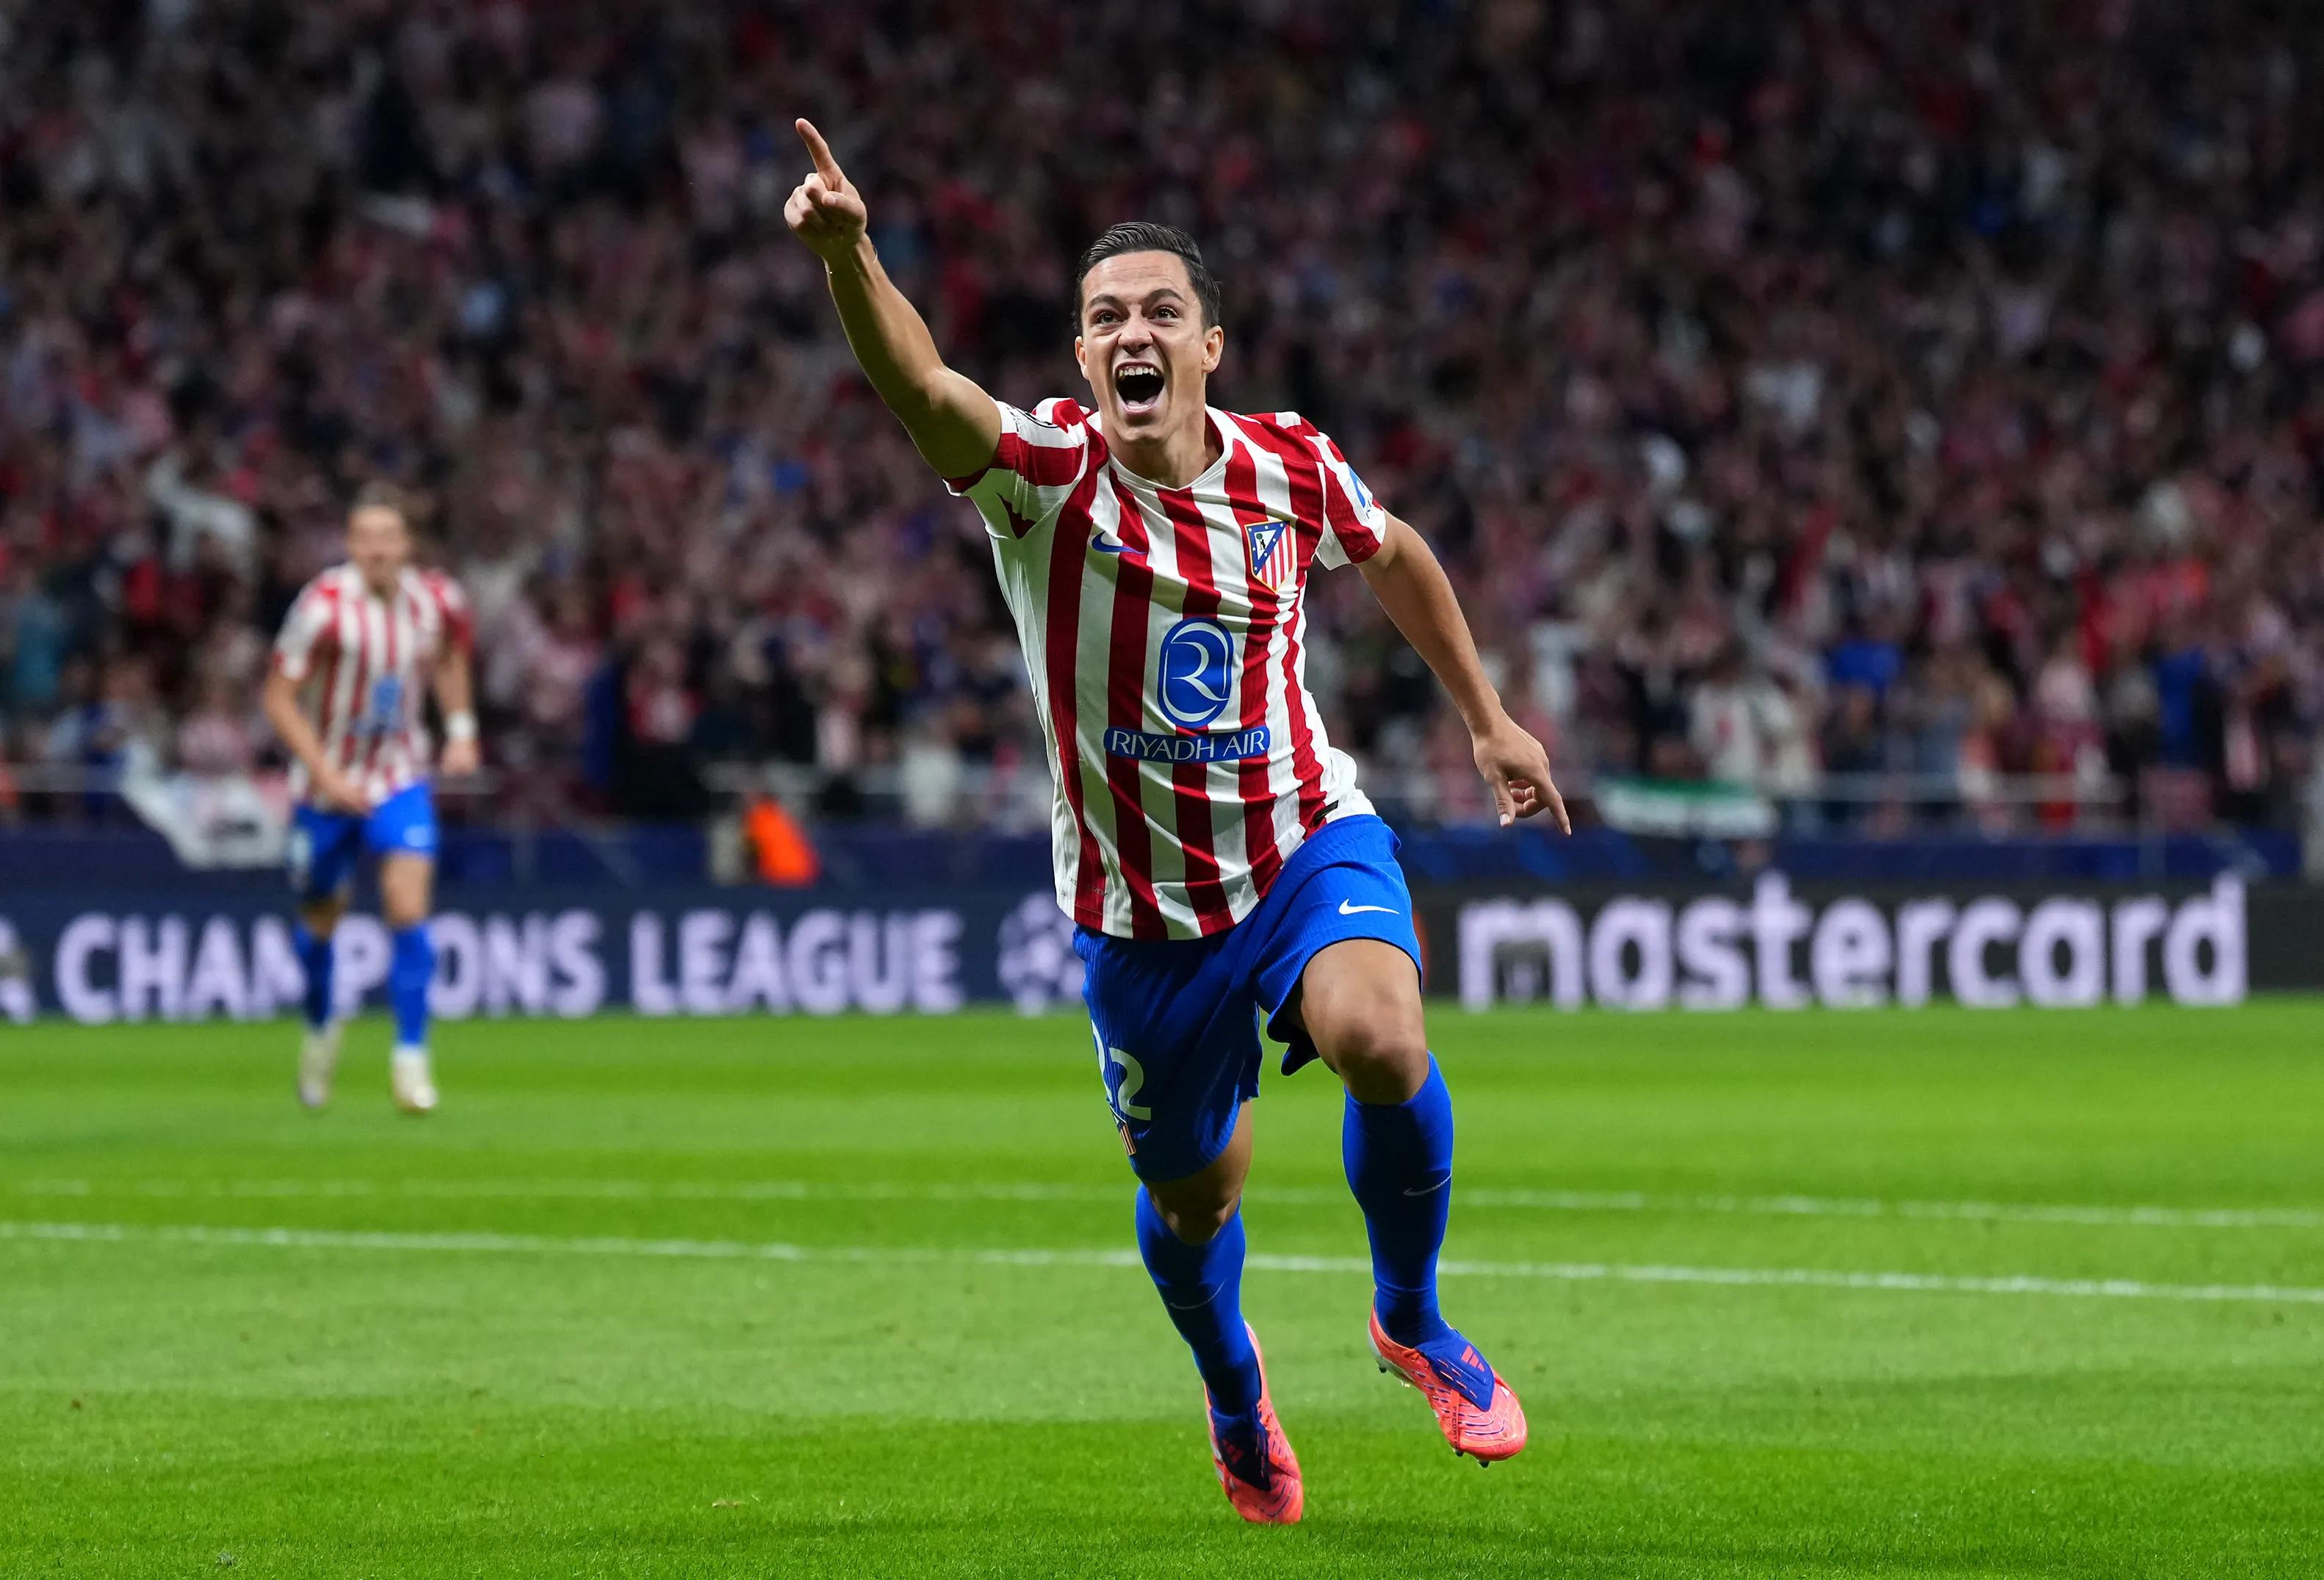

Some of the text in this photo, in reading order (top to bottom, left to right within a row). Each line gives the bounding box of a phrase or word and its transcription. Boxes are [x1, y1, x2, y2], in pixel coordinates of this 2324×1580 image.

[1166, 622, 1230, 703] R
[1111, 729, 1266, 760] RIYADH AIR
[54, 908, 963, 1023] CHAMPONS LEAGUE
[1457, 872, 2248, 1011] mastercard
